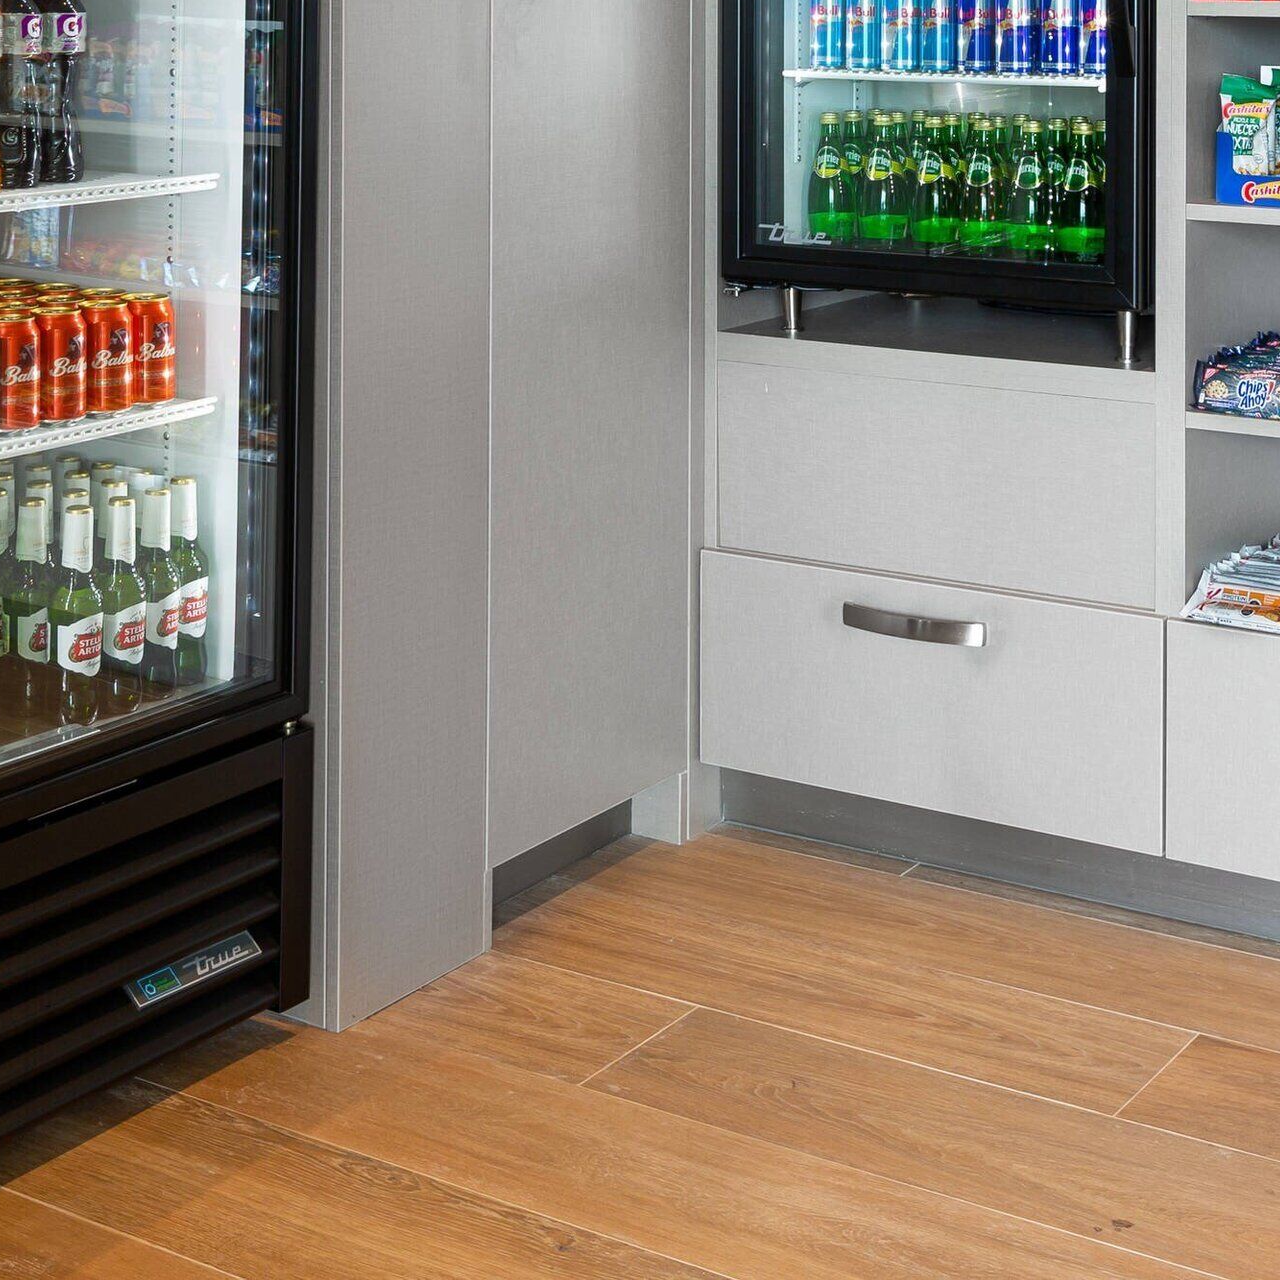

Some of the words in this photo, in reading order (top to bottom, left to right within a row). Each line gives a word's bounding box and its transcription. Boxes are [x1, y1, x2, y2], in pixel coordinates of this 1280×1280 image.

[62, 15, 80, 37] G
[1237, 379, 1268, 398] Chips
[186, 599, 208, 611] STELL
[185, 607, 208, 618] ARTO
[124, 624, 145, 636] STELL
[78, 636, 102, 647] STELL
[122, 634, 144, 645] ARTO
[77, 645, 102, 656] ARTO
